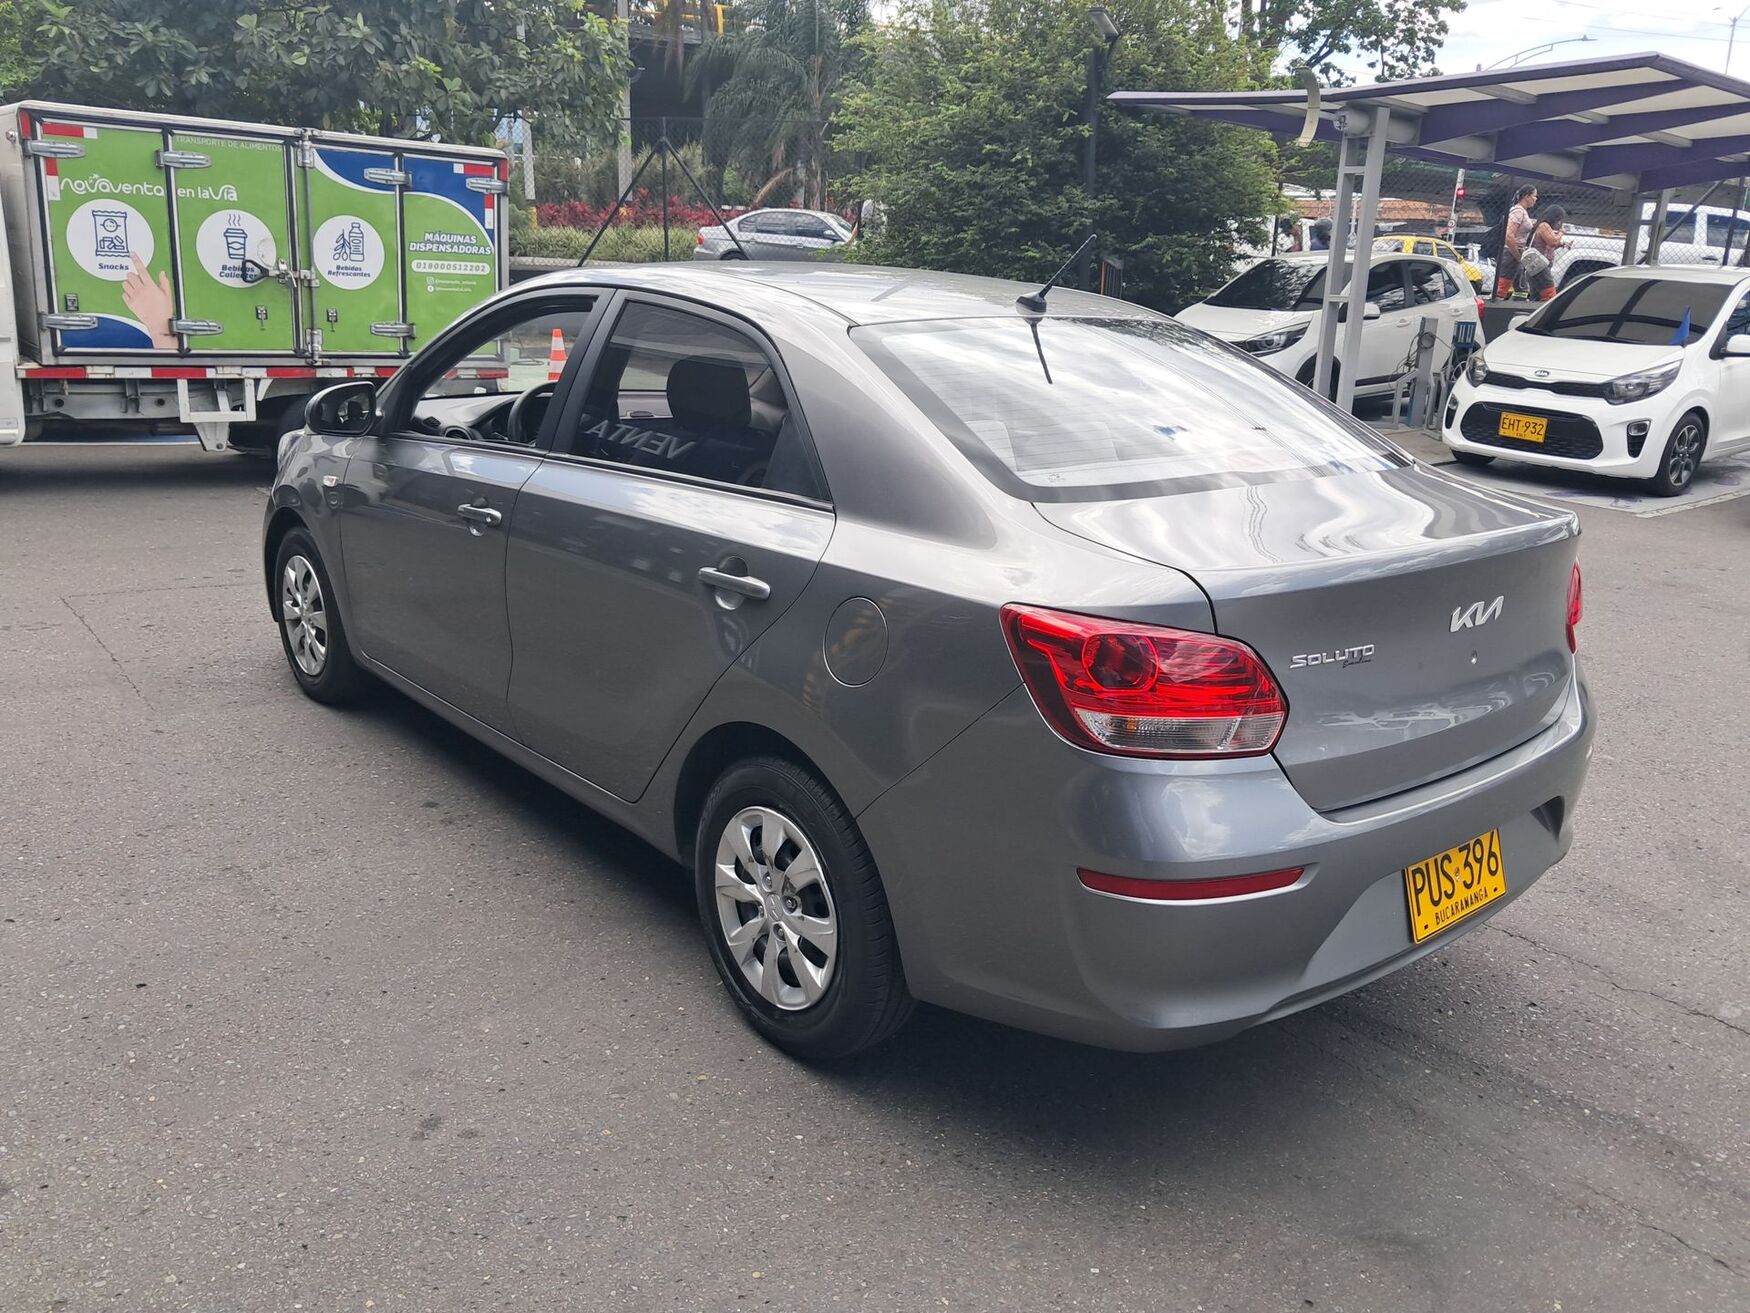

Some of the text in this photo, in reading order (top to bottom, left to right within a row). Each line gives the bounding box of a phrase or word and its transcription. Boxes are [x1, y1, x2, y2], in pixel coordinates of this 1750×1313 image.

[176, 136, 283, 153] TRANSPORTE DE ALIMENTOS
[177, 187, 195, 198] en
[424, 231, 477, 244] MÁQUINAS
[409, 242, 492, 255] DISPENSADORAS
[98, 262, 129, 271] Snacks
[221, 264, 255, 273] Bebias
[416, 261, 486, 272] 018000512202
[1450, 595, 1505, 633] KIA
[1289, 643, 1375, 669] SOLUTO
[1435, 886, 1489, 926] BUCARAMANGA
